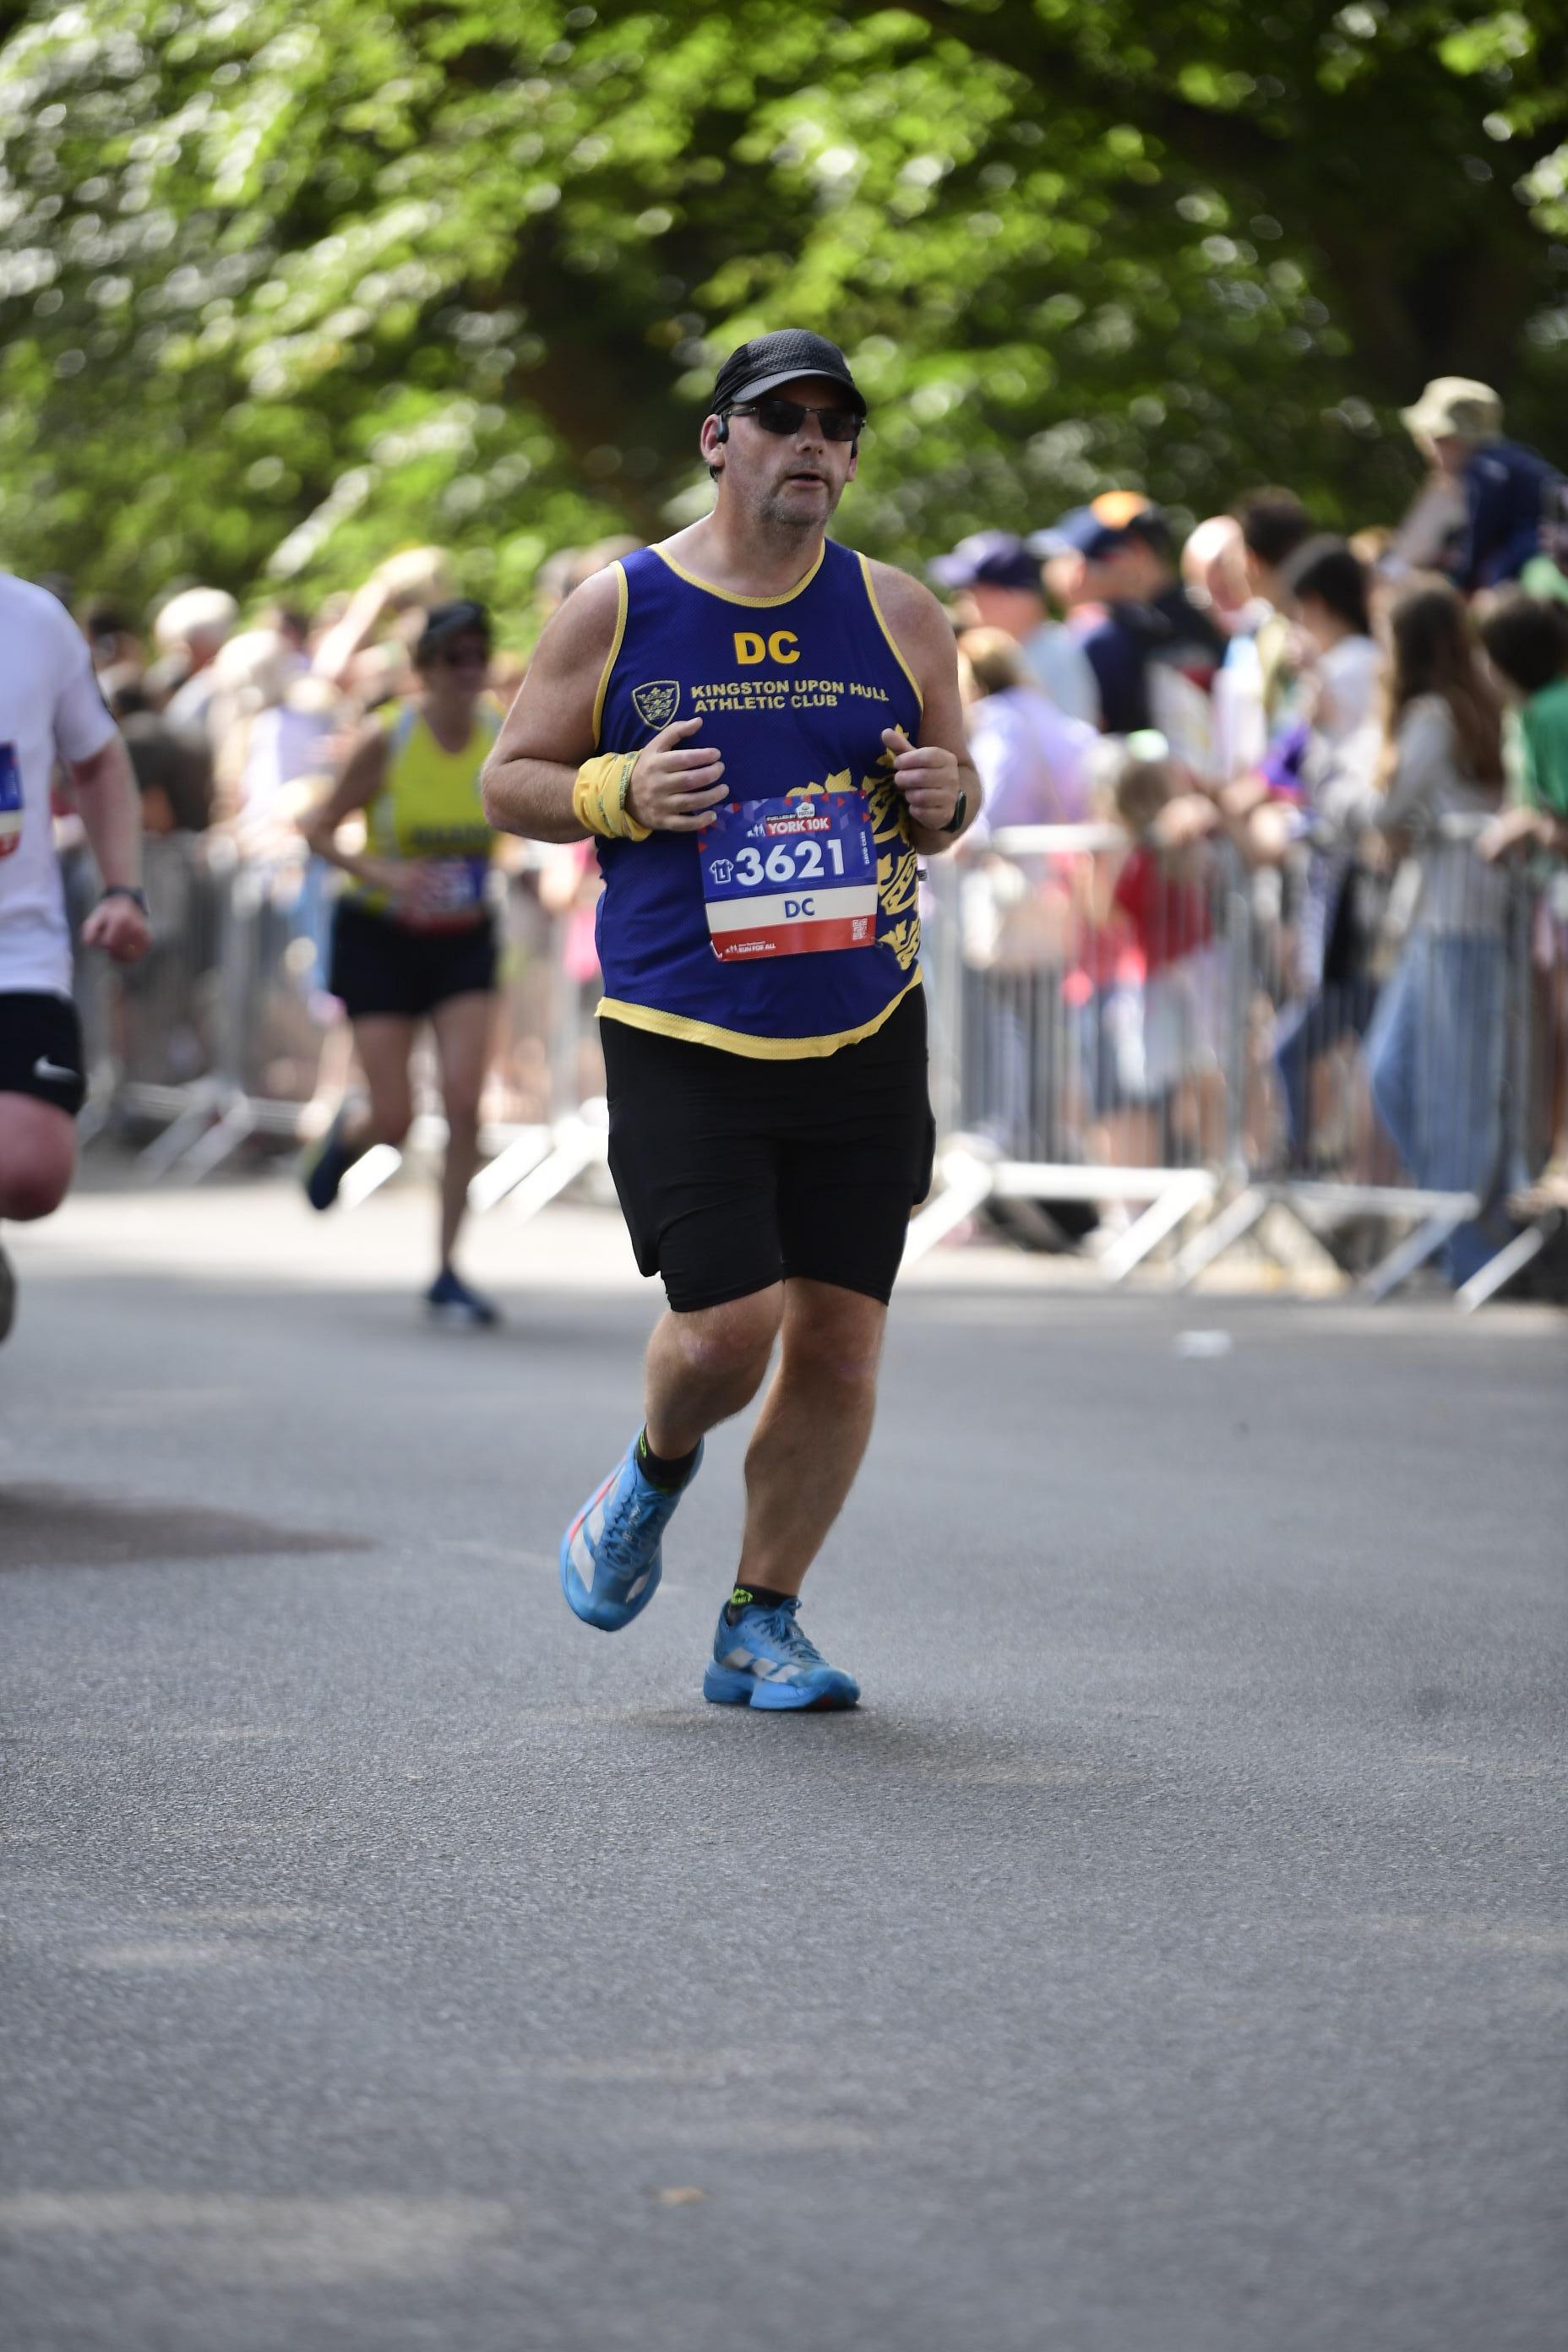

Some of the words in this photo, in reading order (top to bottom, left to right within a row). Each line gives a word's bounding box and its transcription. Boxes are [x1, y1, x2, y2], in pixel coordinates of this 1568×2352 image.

[733, 630, 801, 664] DC
[691, 680, 790, 699] KINGSTON
[795, 679, 844, 694] UPON
[850, 683, 890, 701] HULL
[694, 695, 786, 713] ATHLETIC
[791, 694, 838, 708] CLUB
[768, 819, 806, 834] YORK
[807, 818, 829, 830] 10K
[736, 839, 844, 885] 3621
[720, 868, 727, 879] L
[784, 897, 815, 918] DC
